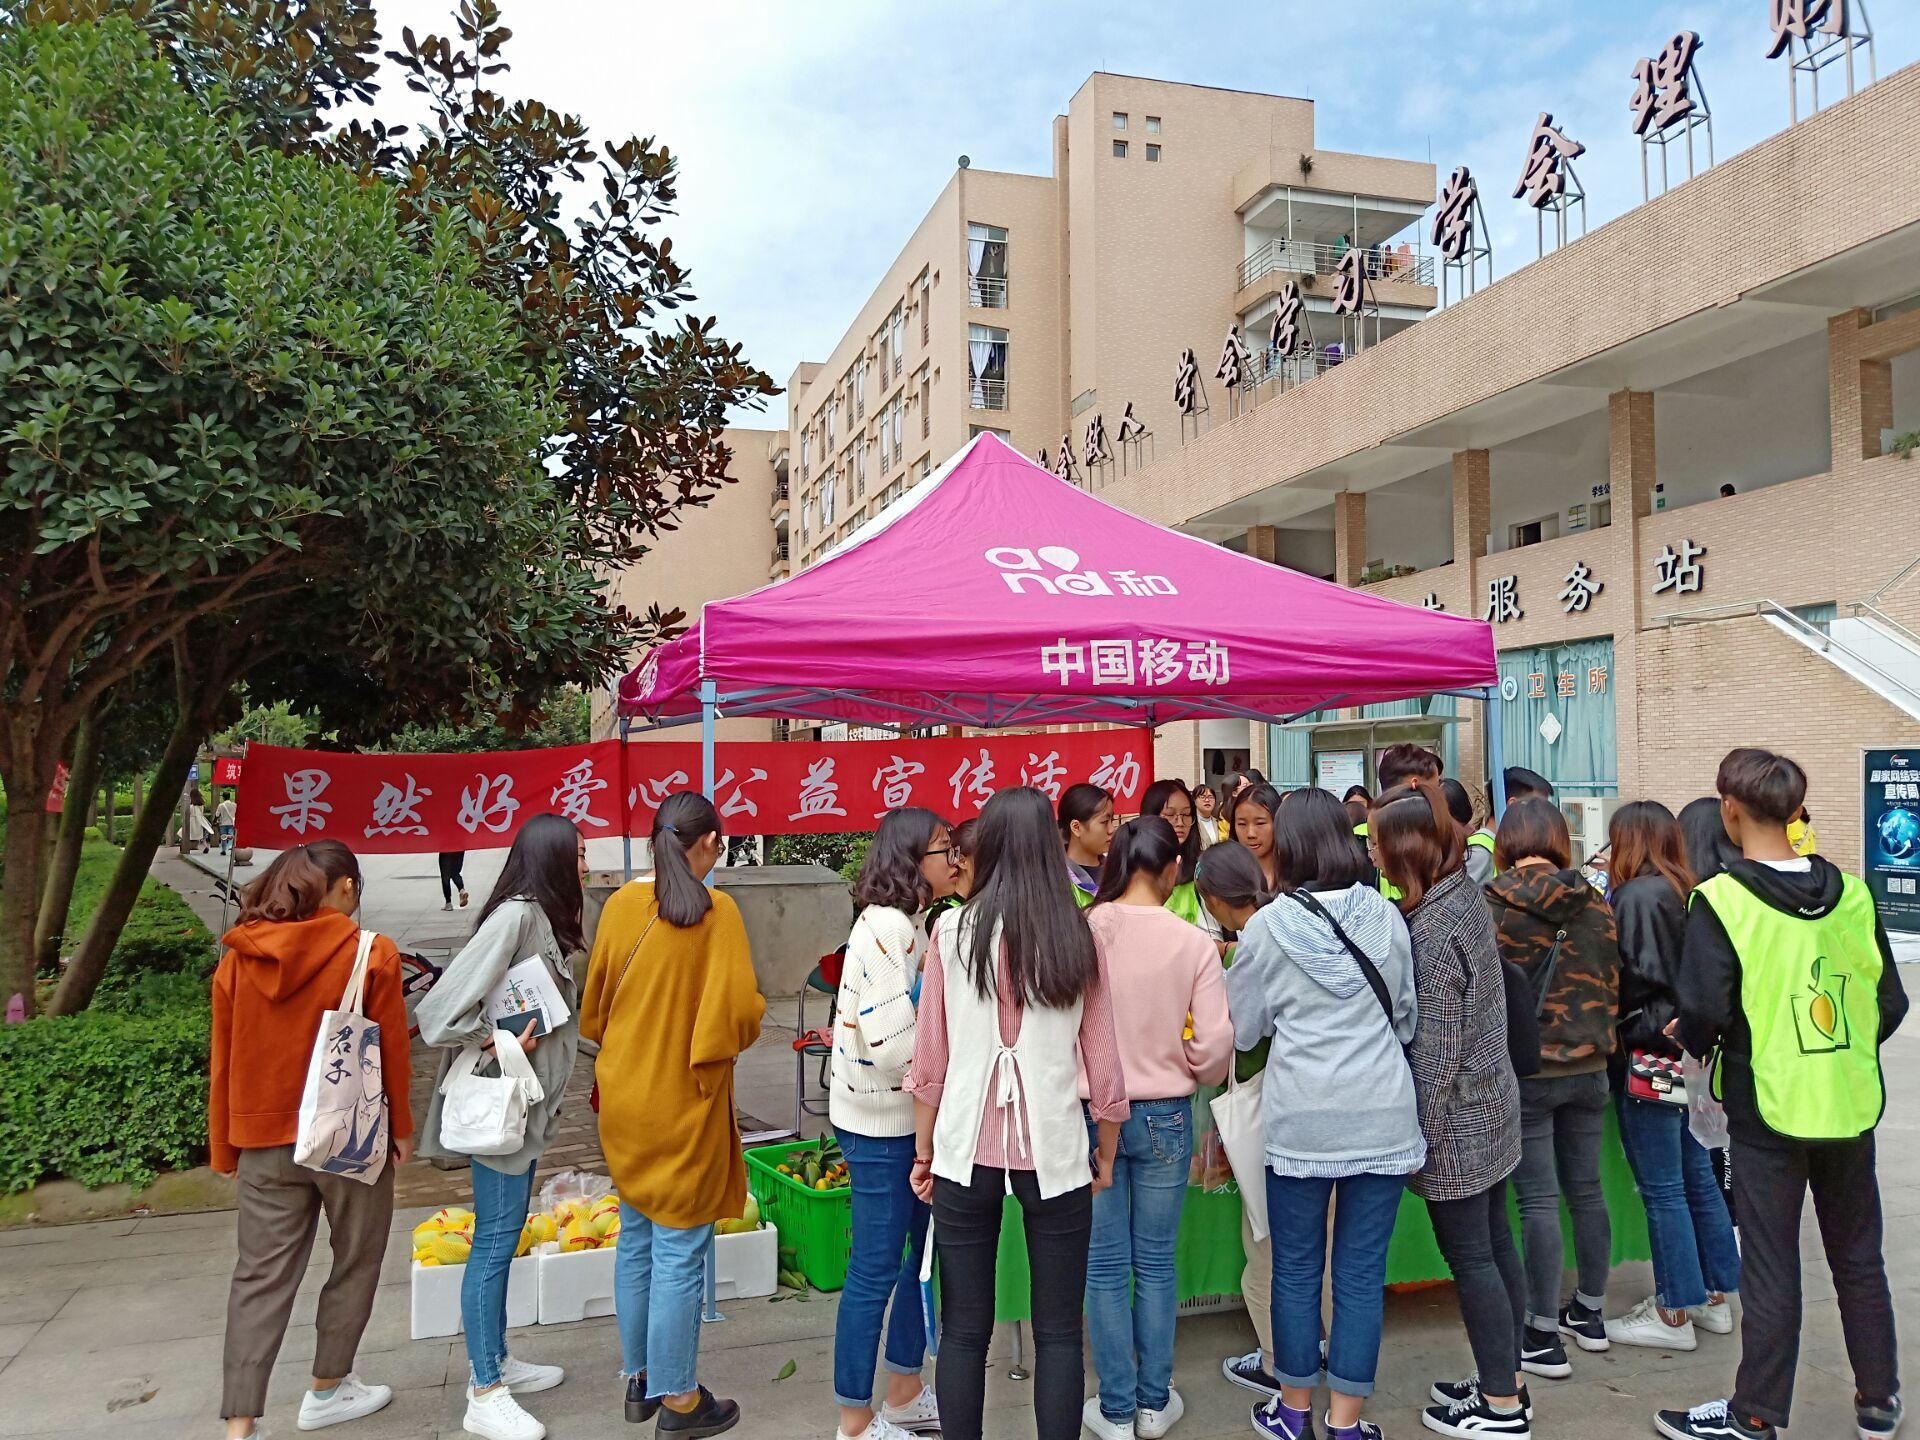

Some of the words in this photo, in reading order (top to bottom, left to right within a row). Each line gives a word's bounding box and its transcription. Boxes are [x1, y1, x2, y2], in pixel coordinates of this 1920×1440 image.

[1174, 248, 1364, 413] 学会学习
[1107, 569, 1179, 597] 和
[1040, 637, 1230, 686] 中国移动
[1527, 665, 1608, 699] 卫生所
[1870, 769, 1920, 783] 国家网络安
[325, 1025, 354, 1085] 君子
